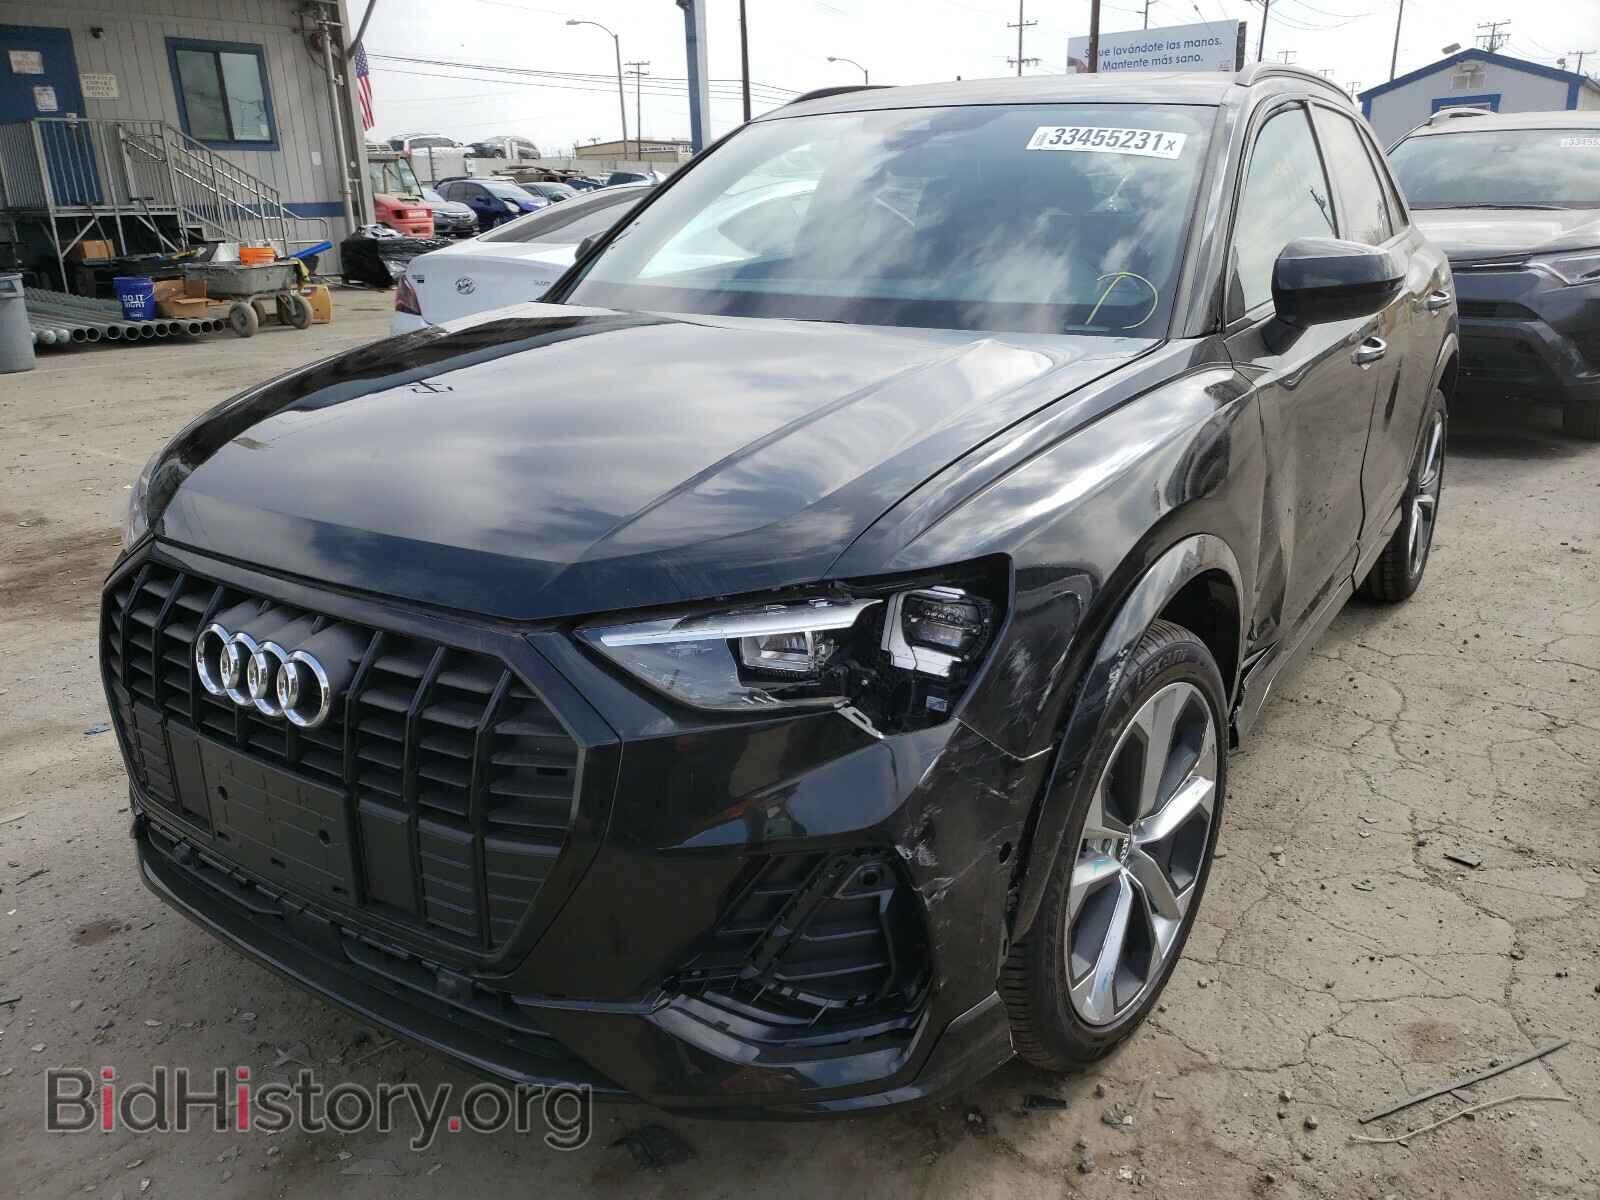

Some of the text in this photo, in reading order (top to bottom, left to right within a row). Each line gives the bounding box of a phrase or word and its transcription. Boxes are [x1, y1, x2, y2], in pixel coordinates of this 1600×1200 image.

[1084, 37, 1222, 58] Sue lavándote las manos.
[1102, 53, 1204, 71] Mantente más sano.
[1048, 127, 1164, 151] 33455231
[122, 294, 145, 302] DO IT
